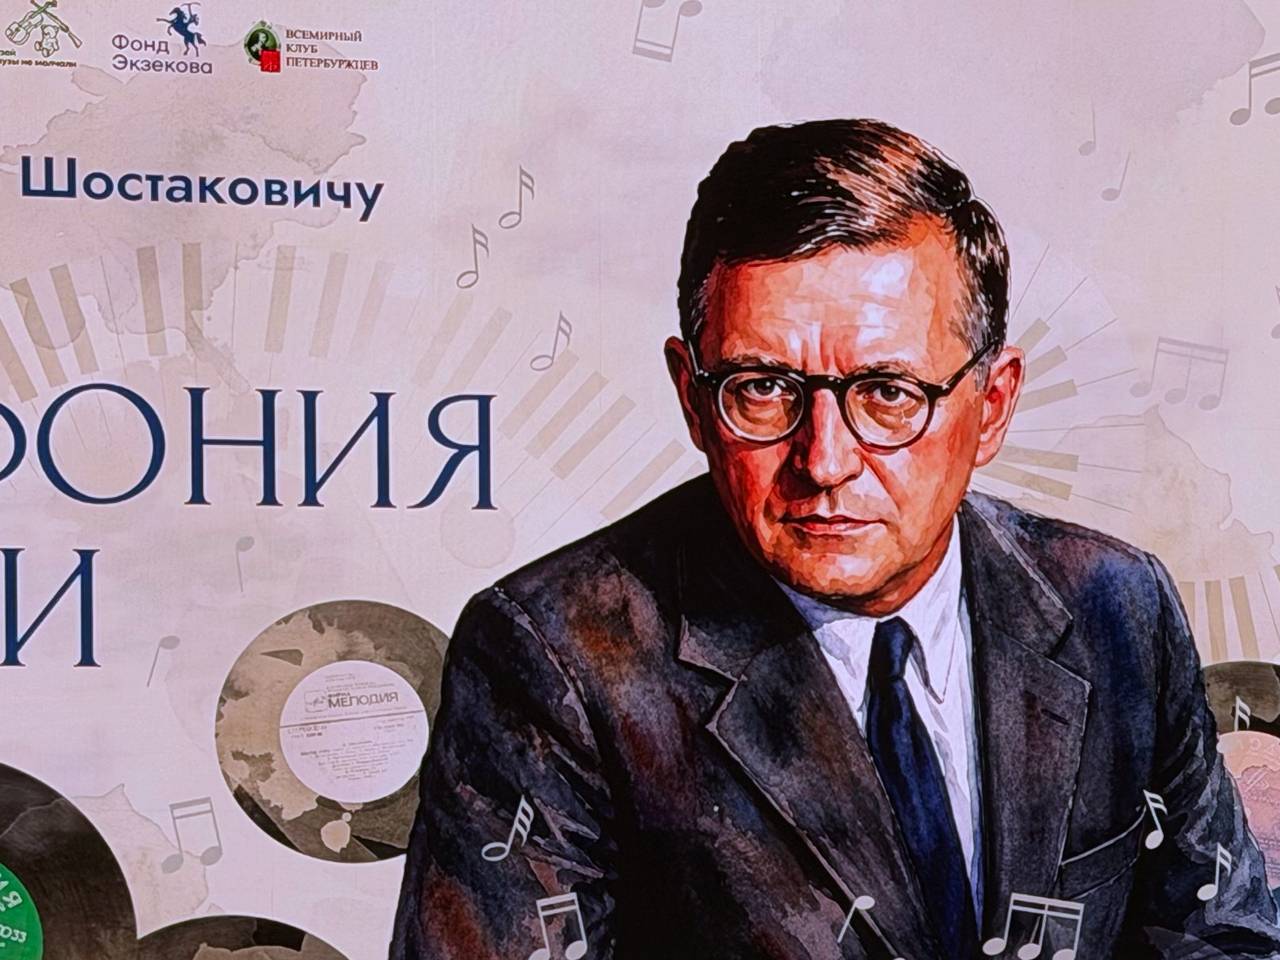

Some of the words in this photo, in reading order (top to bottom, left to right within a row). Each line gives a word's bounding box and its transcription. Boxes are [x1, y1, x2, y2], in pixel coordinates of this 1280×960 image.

[112, 34, 170, 55] Фонд
[285, 29, 363, 42] ВСЕМИРНЫЙ
[285, 43, 318, 54] КЛУБ
[112, 54, 213, 74] Экзекова
[285, 57, 379, 71] ПЕТЕРБУРЖЦЕВ
[21, 155, 384, 222] Шостаковичу
[0, 547, 101, 668] И
[328, 692, 399, 709] МЕЛОДИЯ
